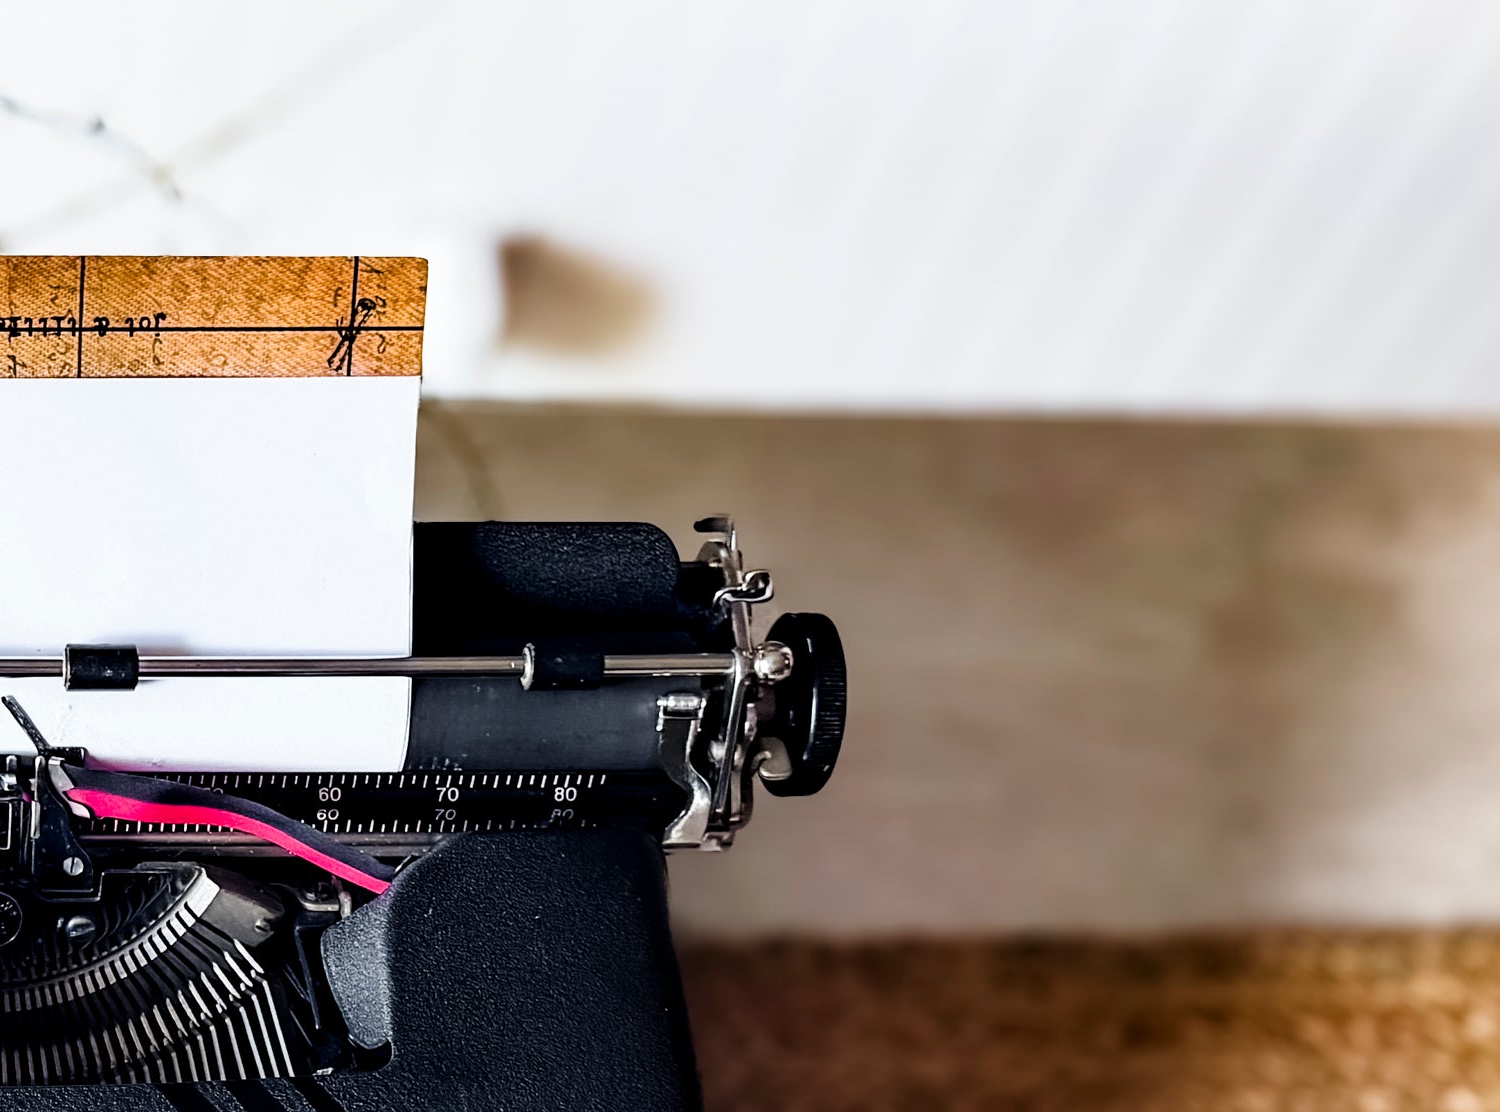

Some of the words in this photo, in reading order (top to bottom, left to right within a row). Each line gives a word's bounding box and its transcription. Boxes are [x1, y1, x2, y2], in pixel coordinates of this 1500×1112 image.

[319, 786, 341, 801] 60
[437, 788, 459, 801] 70
[555, 788, 577, 801] 80
[317, 810, 338, 820] 60
[436, 809, 456, 820] 70
